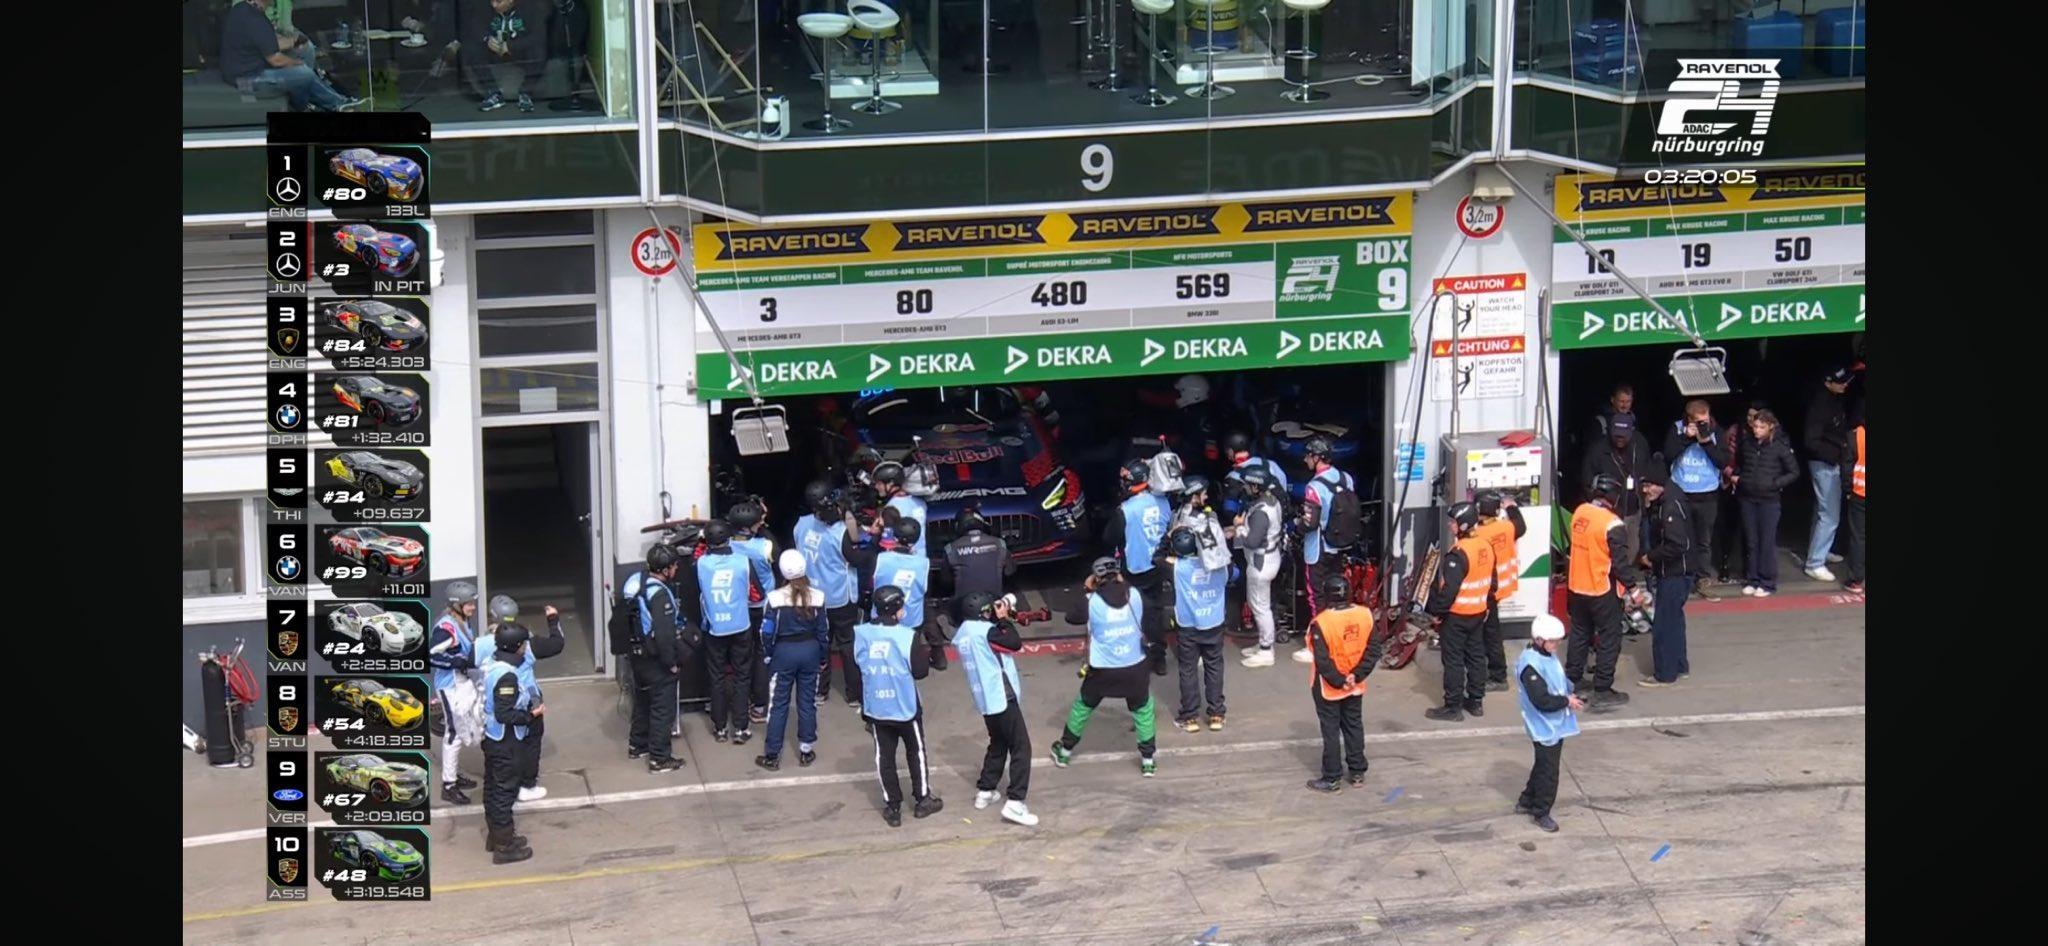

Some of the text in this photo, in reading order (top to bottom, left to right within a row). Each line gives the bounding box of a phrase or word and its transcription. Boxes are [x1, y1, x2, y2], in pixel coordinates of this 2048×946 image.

[1080, 144, 1114, 192] 9
[1589, 184, 1713, 204] RAVENOL
[1083, 214, 1207, 234] RAVENOL
[1257, 204, 1380, 225] RAVENOL
[1801, 214, 1825, 222] RACING
[731, 232, 856, 253] RAVENOL
[908, 223, 1032, 243] RAVENOL
[1356, 239, 1408, 265] BOX
[1681, 243, 1711, 268] 19
[1775, 237, 1812, 262] 50
[865, 268, 915, 277] MERCEDES-AMG
[1585, 249, 1615, 274] 10
[700, 272, 836, 285] MERCEDES-AMG TEAM VERSTAPPEN RACING
[1176, 273, 1230, 299] 569
[1378, 268, 1407, 311] 9
[1454, 279, 1504, 291] CAUTION
[897, 289, 932, 315] 80
[1031, 281, 1087, 307] 480
[760, 297, 777, 322] 3
[1613, 309, 1688, 332] DEKRA
[1751, 300, 1826, 324] DEKRA
[738, 333, 788, 342] MERCEDES-AMG
[884, 325, 933, 334] MERCEDES-AMG
[1309, 329, 1384, 352] DEKRA
[1037, 345, 1112, 367] DEKRA
[1174, 337, 1248, 359] DEKRA
[761, 360, 837, 383] DEKRA
[900, 352, 975, 375] DEKRA
[1484, 367, 1516, 375] GEFAHR
[914, 446, 1004, 464] Red Bull
[960, 487, 1027, 498] AMG
[711, 589, 732, 604] TV
[1104, 625, 1136, 639] MEDIA
